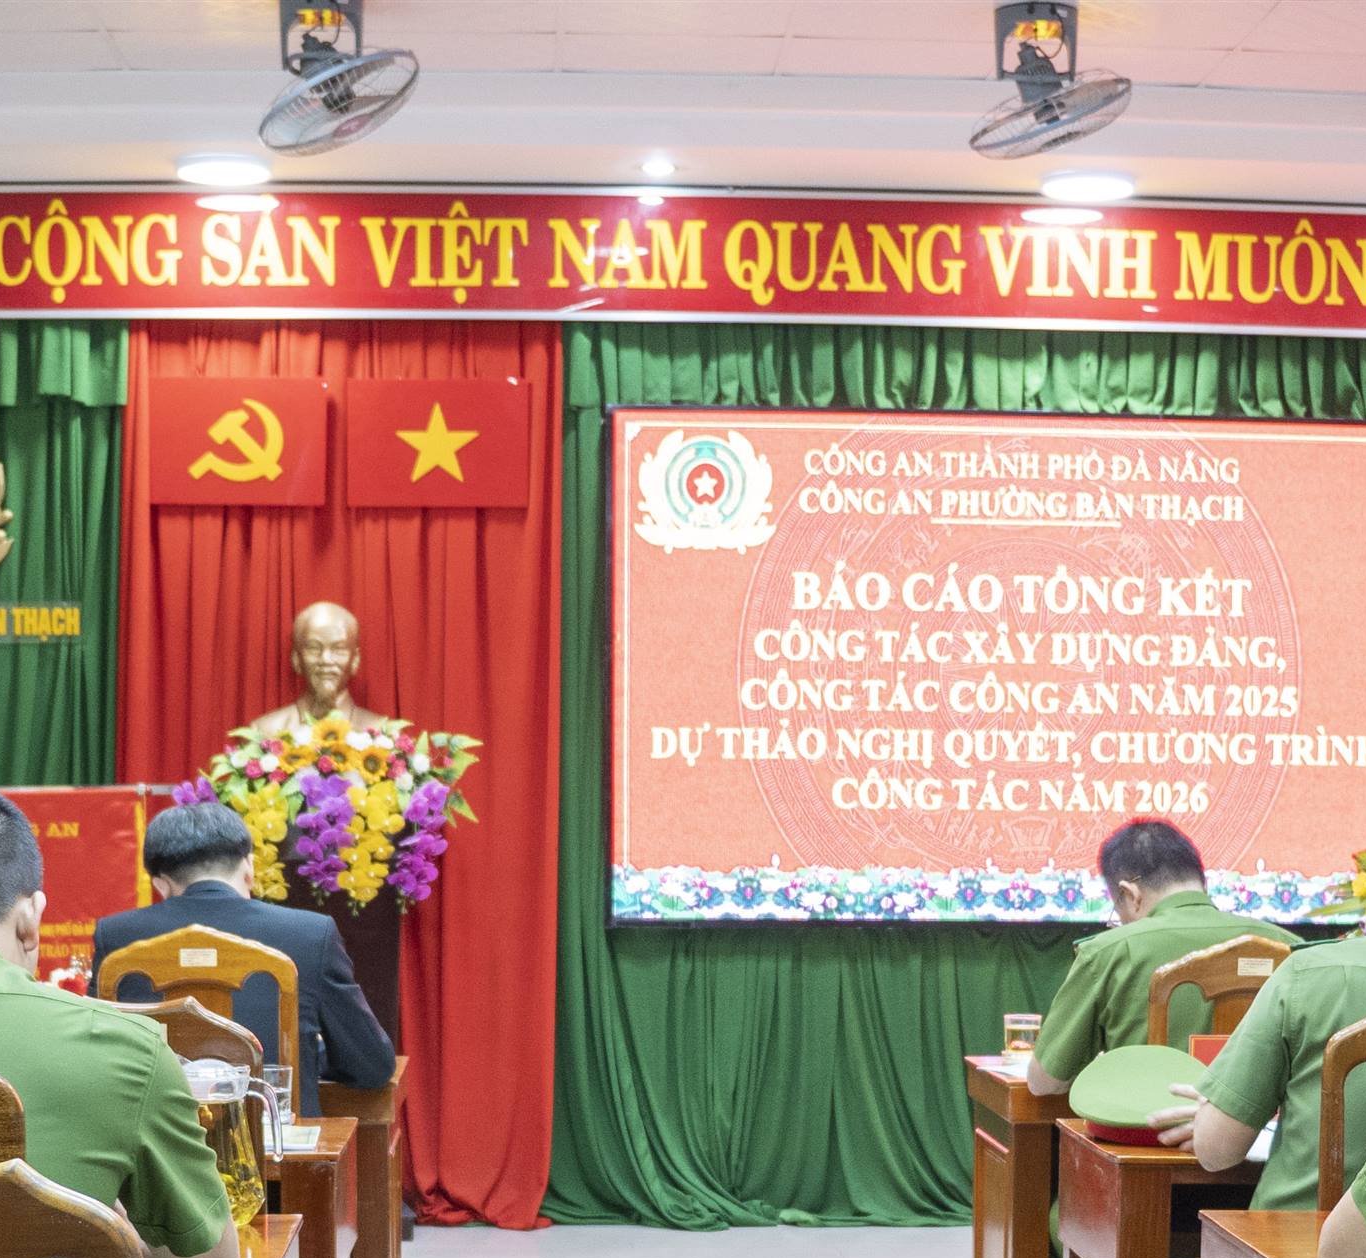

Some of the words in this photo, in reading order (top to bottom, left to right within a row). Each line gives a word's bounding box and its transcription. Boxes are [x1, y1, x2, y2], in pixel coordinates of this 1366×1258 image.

[199, 203, 338, 289] SẢN
[361, 202, 529, 305] VIỆT
[548, 217, 709, 290] NAM
[724, 221, 967, 306] QUANG
[980, 226, 1157, 301] VINH
[804, 443, 886, 476] CÔNG
[893, 451, 932, 477] AN
[940, 443, 1036, 479] THÀNH
[1047, 447, 1105, 480] PHỐ
[1110, 450, 1152, 481] ĐÀ
[1159, 450, 1240, 484] NẴNG
[799, 482, 886, 515] CÔNG
[891, 490, 933, 515] AN
[941, 485, 1067, 518] PHƯỜNG
[1075, 487, 1134, 519] BÀN
[1140, 495, 1244, 526] THẠCH
[792, 560, 891, 612] BÁO
[902, 563, 1004, 613] CÁO
[1014, 565, 1145, 615] TỔNG
[1158, 569, 1252, 617] KẾT
[11, 607, 81, 642] THẠCH
[753, 619, 867, 662] CÔNG
[875, 622, 953, 663] TÁC
[962, 622, 1043, 665] XÂY
[1051, 632, 1161, 672] DỰNG
[1170, 627, 1287, 674] ĐẢNG,
[740, 668, 853, 711] CÔNG
[860, 671, 940, 712] TÁC
[949, 671, 1060, 713] CÔNG
[1067, 682, 1120, 715] AN
[1129, 676, 1215, 716] NĂM
[1225, 685, 1298, 718] 2025
[650, 721, 711, 767] DỰ
[716, 718, 827, 760] THẢO
[835, 728, 935, 769] NGHỊ
[943, 721, 1082, 769] QUYẾT,
[1090, 728, 1257, 766] CHƯƠNG
[832, 767, 944, 810] CÔNG
[952, 770, 1030, 811] TÁC
[1038, 773, 1127, 812] NĂM
[1134, 781, 1210, 813] 2026
[47, 822, 80, 838] AN
